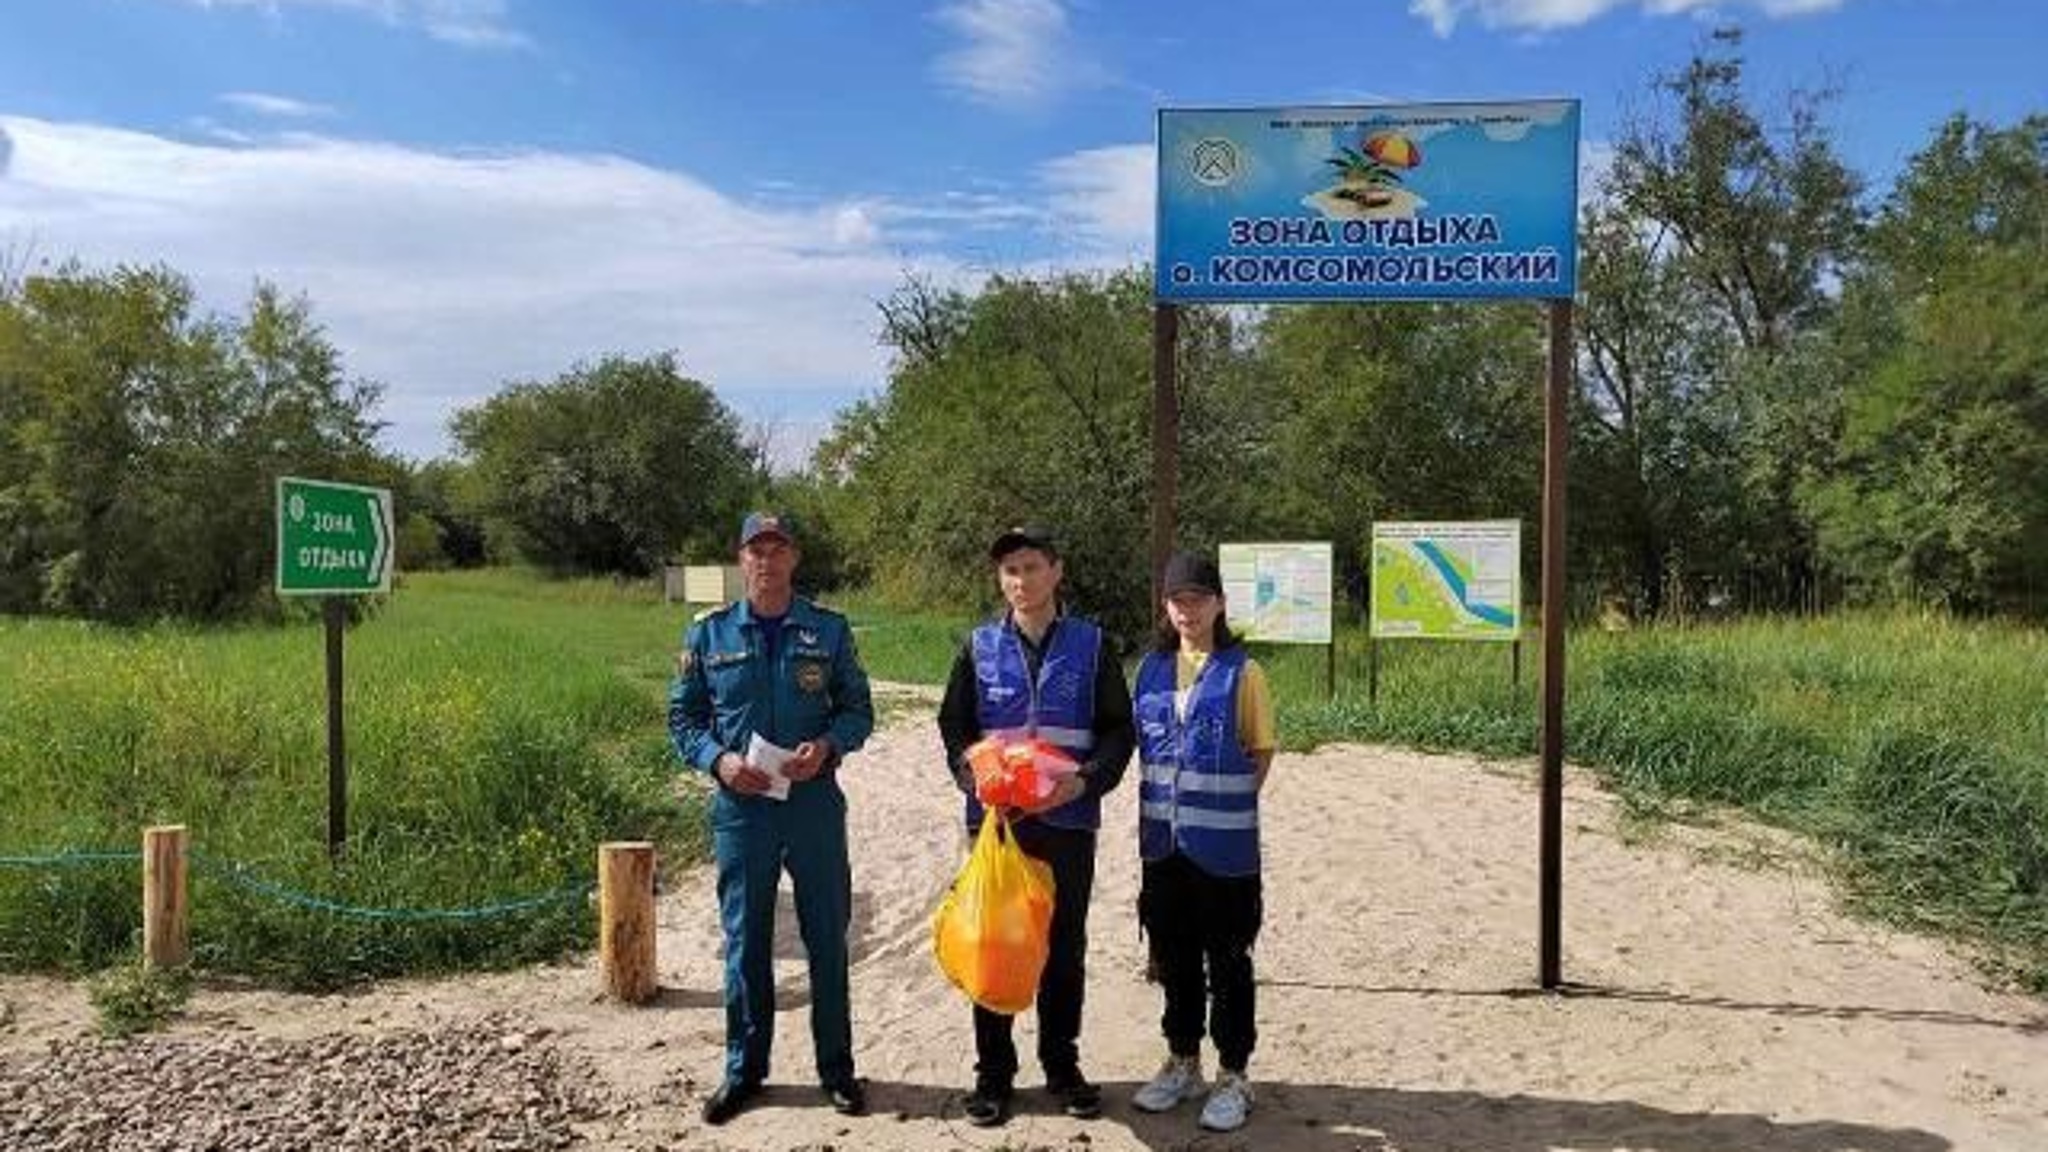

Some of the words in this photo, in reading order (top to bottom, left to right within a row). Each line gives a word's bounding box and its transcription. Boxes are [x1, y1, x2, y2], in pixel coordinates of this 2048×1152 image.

[1230, 219, 1332, 246] ЗОНА
[1343, 216, 1500, 247] ОТДЫХА
[1212, 248, 1558, 283] КОМСОМОЛЬСКИЙ
[312, 511, 356, 536] ЗОНА
[298, 546, 368, 572] ОТДЫХА
